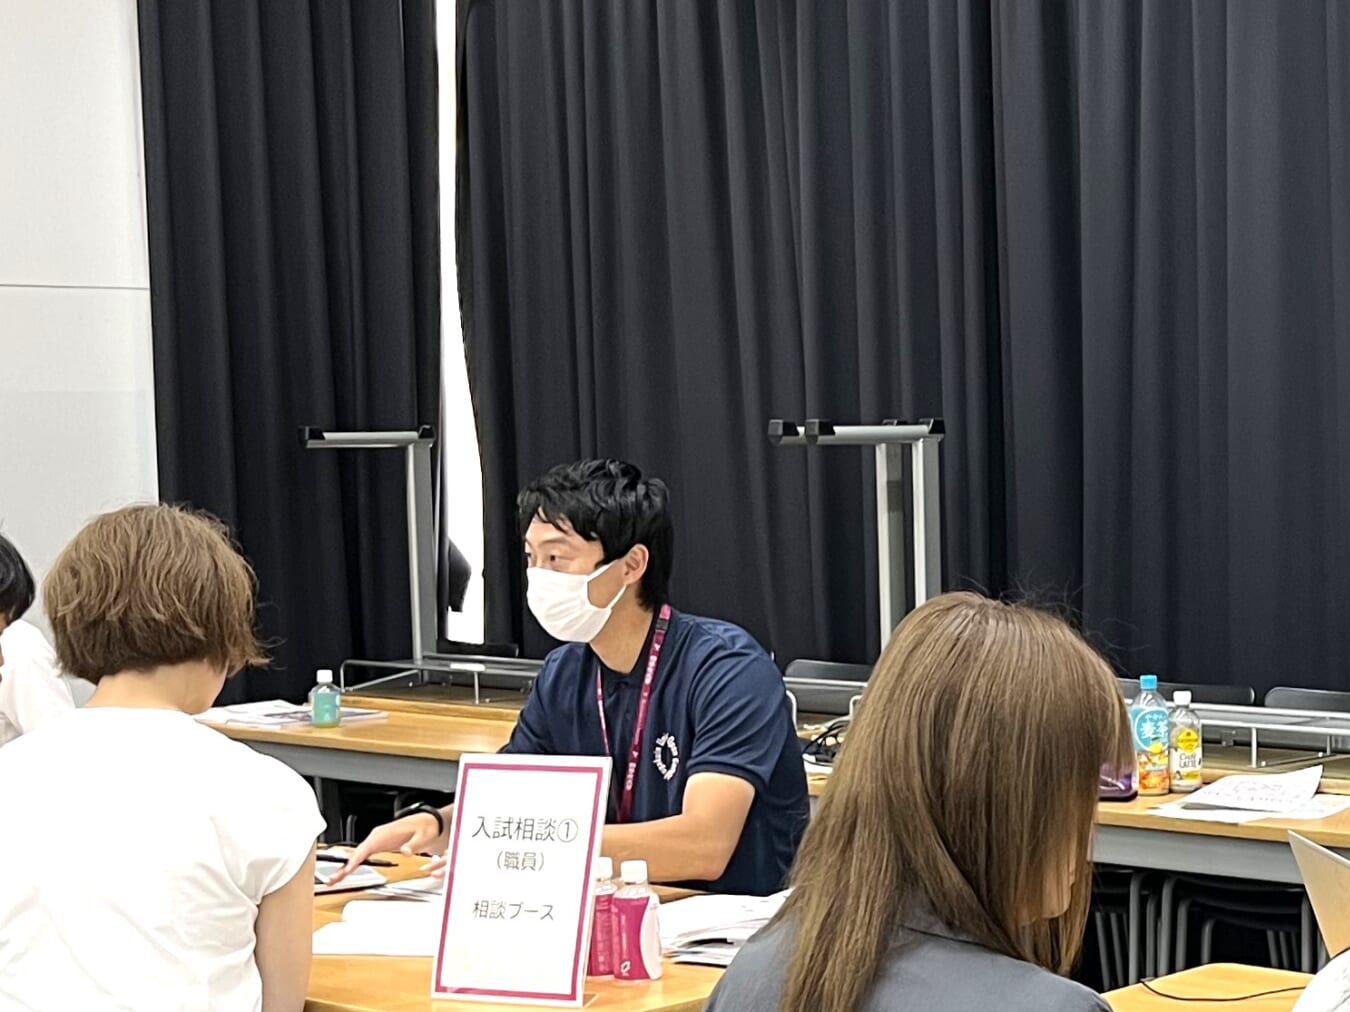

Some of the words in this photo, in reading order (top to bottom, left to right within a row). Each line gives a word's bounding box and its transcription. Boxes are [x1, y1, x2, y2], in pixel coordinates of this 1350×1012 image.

[472, 815, 578, 842] 入試相談①
[496, 851, 545, 872] （職員）
[472, 899, 554, 921] 相談ブース
